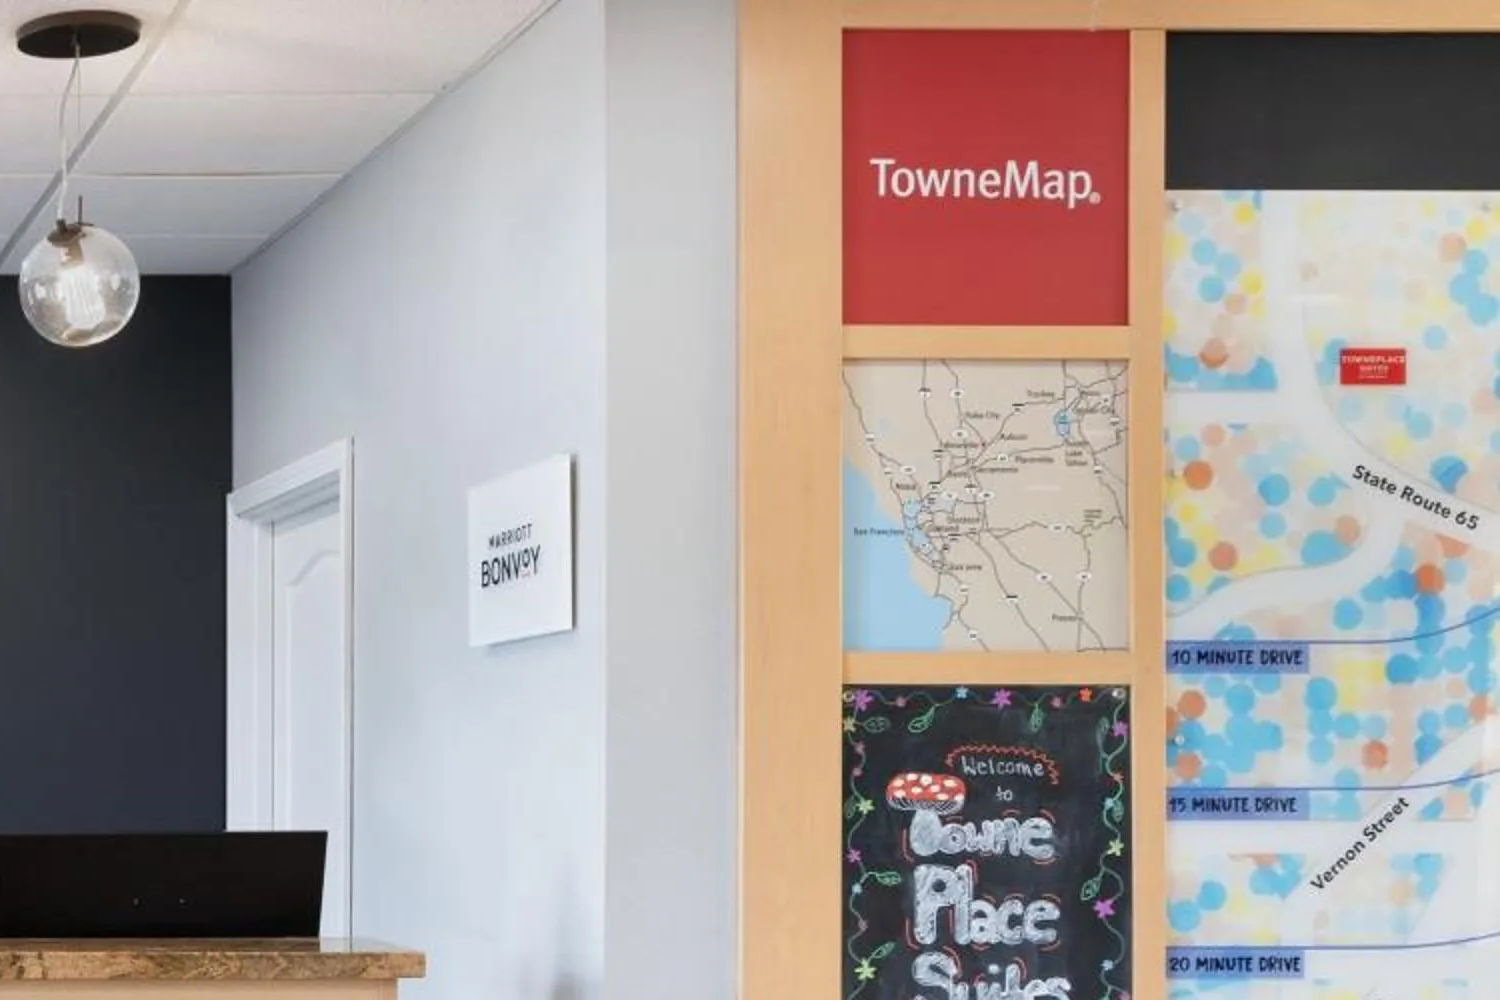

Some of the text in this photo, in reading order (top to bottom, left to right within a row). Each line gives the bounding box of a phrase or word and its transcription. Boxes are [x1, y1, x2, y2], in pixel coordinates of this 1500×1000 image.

[1351, 464, 1481, 531] State Route 65
[488, 523, 533, 549] MARRIOTT
[481, 544, 541, 588] BONVOY
[1171, 649, 1304, 666] 10 MINUTE DRIVE
[961, 754, 1045, 777] Welcome
[995, 784, 1014, 801] to
[1168, 797, 1298, 814] 15 MINUTE DRIVE
[1310, 796, 1410, 893] Vernon Street
[913, 864, 1061, 945] Place
[1169, 956, 1301, 973] 20 MINUTE DRIVE
